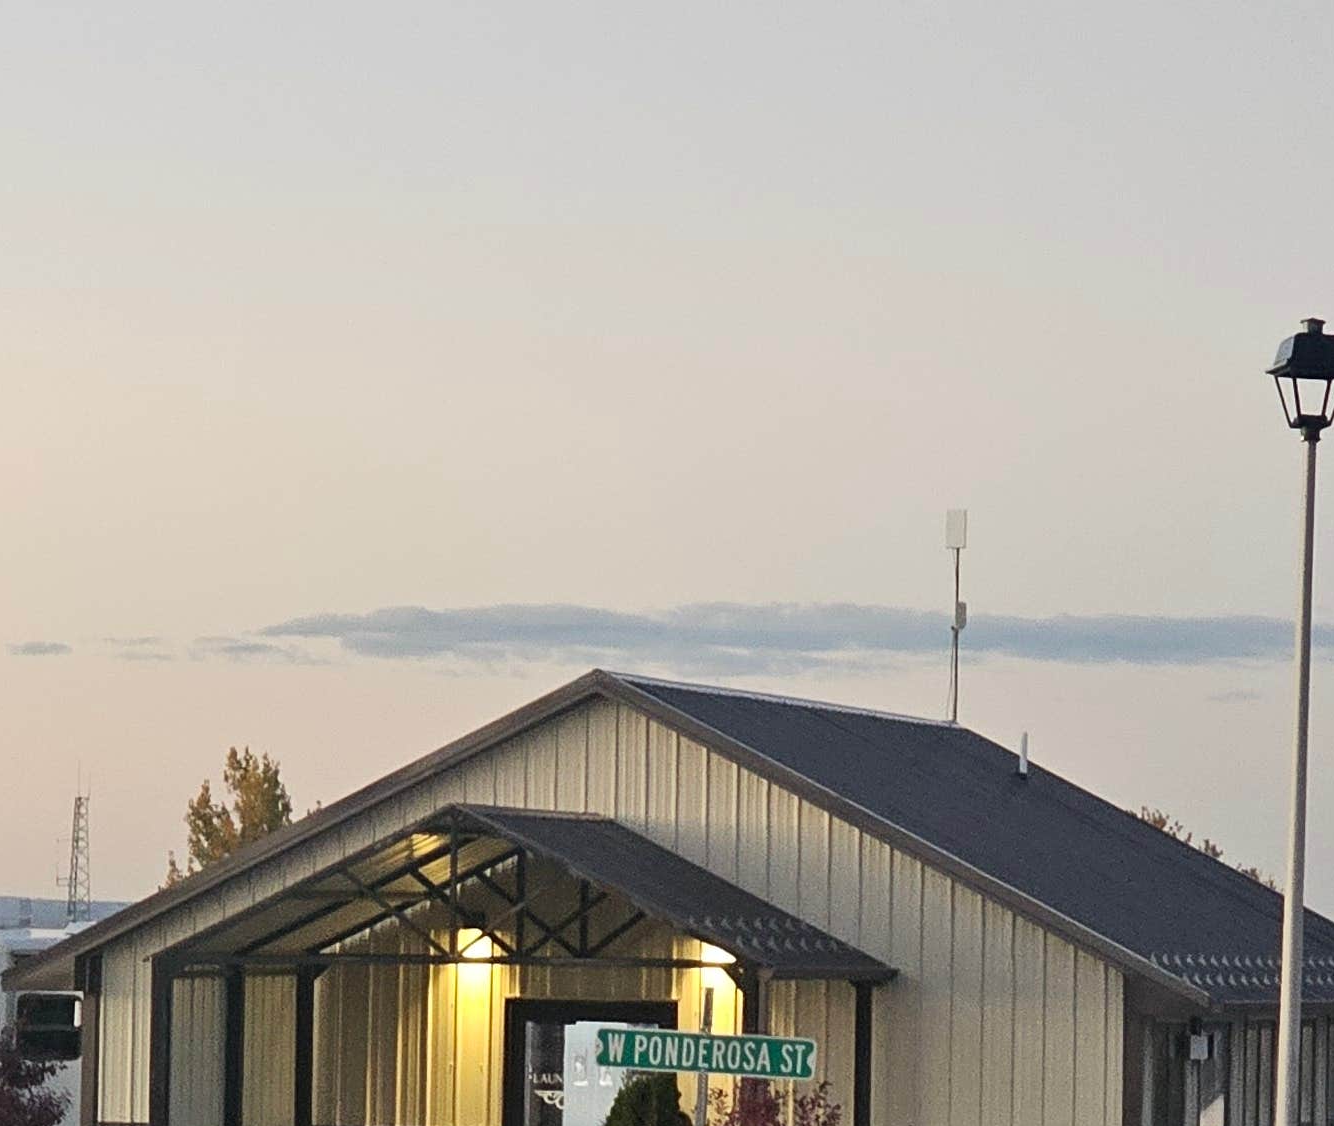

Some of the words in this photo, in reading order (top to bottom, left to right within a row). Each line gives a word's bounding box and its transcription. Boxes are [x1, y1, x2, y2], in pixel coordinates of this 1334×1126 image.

[607, 1033, 626, 1063] W
[634, 1035, 771, 1073] PONDEROSA
[780, 1044, 806, 1075] ST
[533, 1073, 563, 1085] LAUN
